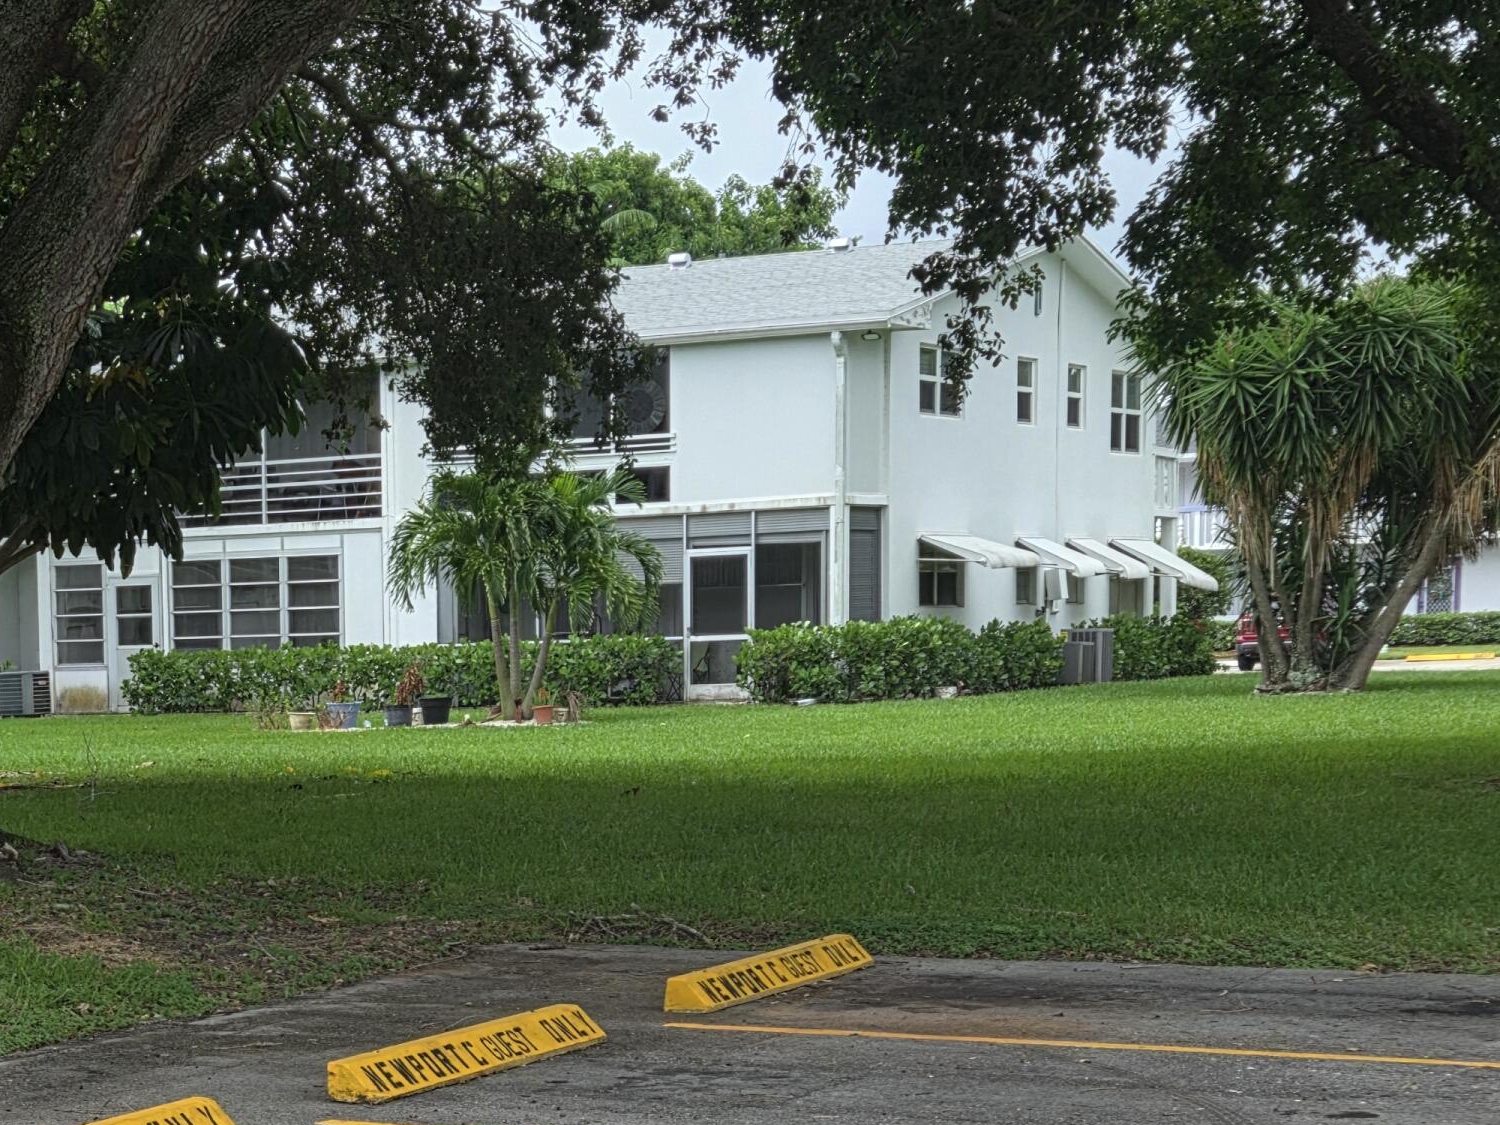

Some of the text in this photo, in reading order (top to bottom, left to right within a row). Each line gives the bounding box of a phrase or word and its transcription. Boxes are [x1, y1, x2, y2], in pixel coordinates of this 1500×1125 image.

[696, 938, 867, 1004] NEWPORT C GUEST ONLY
[360, 1010, 597, 1093] NEWPORT C GUEST ONLY
